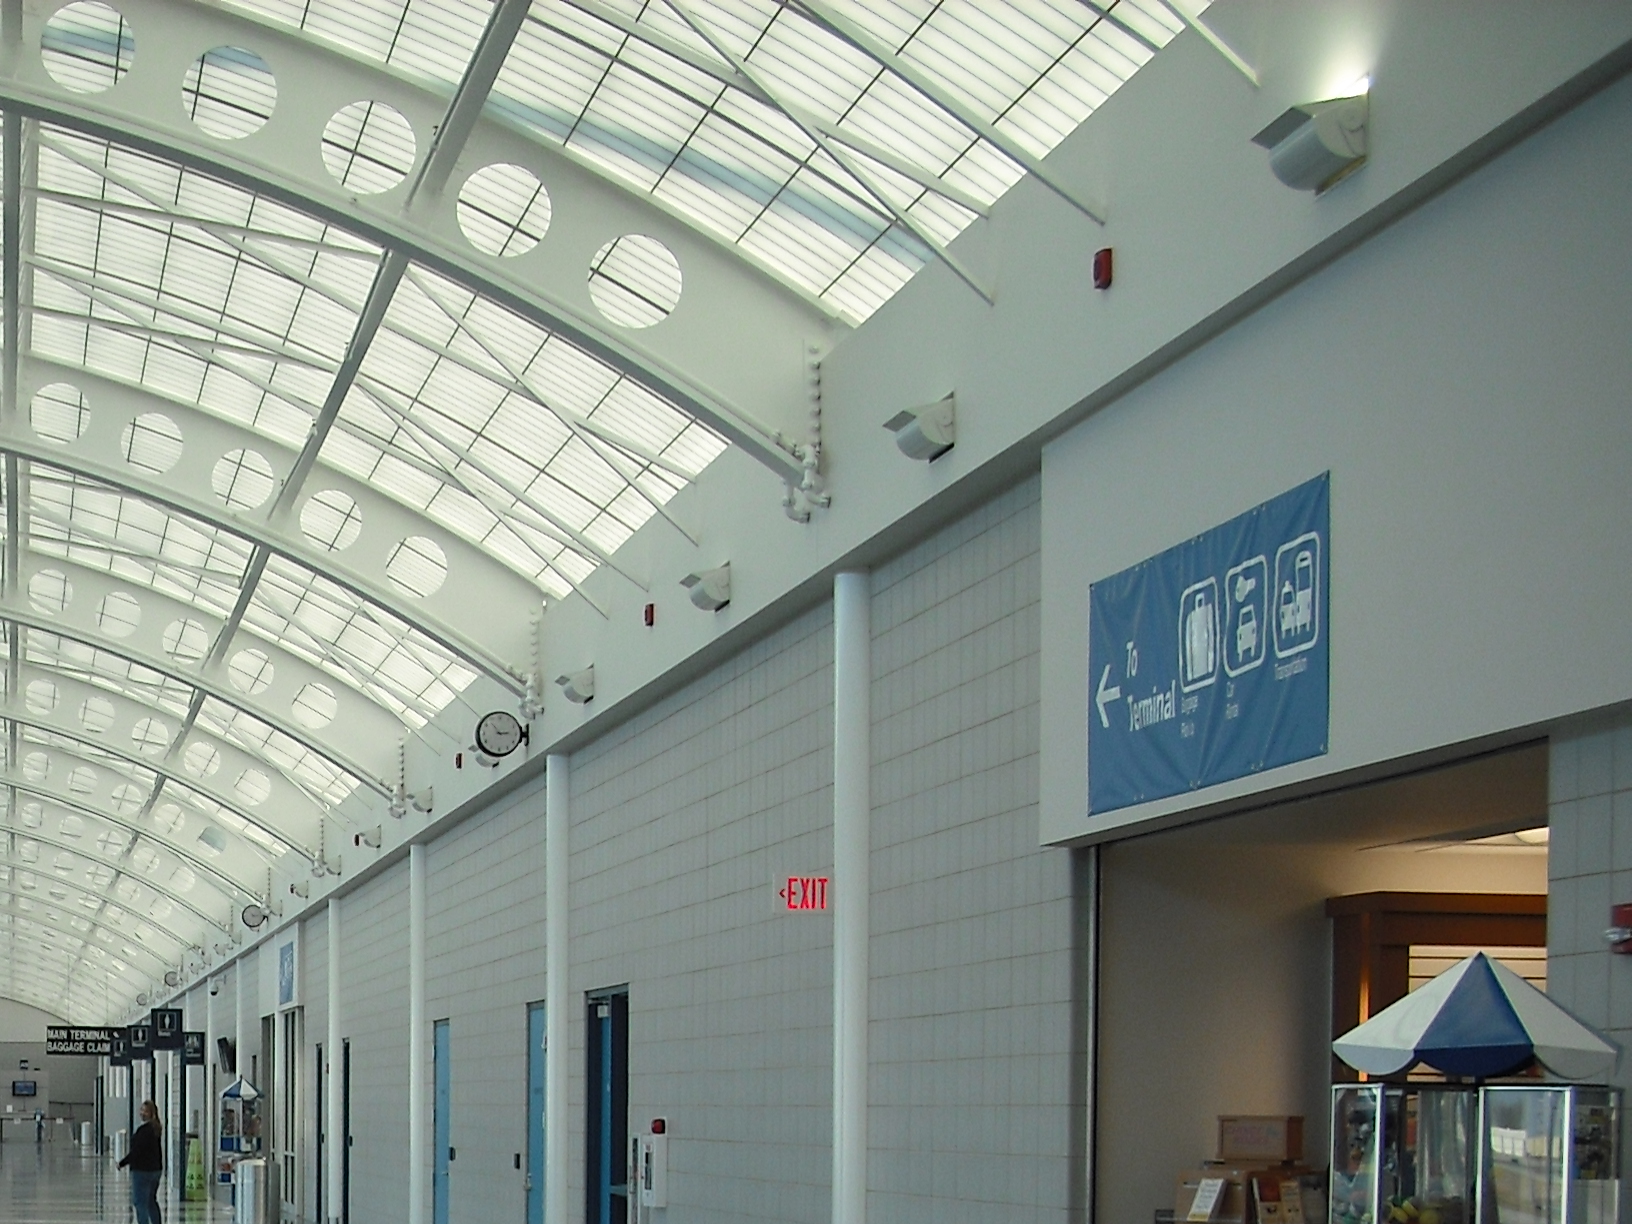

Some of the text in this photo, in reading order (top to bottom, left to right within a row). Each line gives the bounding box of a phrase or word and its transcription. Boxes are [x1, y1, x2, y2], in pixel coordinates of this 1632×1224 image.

[1126, 641, 1138, 678] To
[1127, 679, 1176, 732] Terminal
[787, 877, 828, 909] EXIT
[47, 1029, 111, 1041] MAIN TERMINAL
[47, 1041, 111, 1053] BAGGAGE CLAIM
